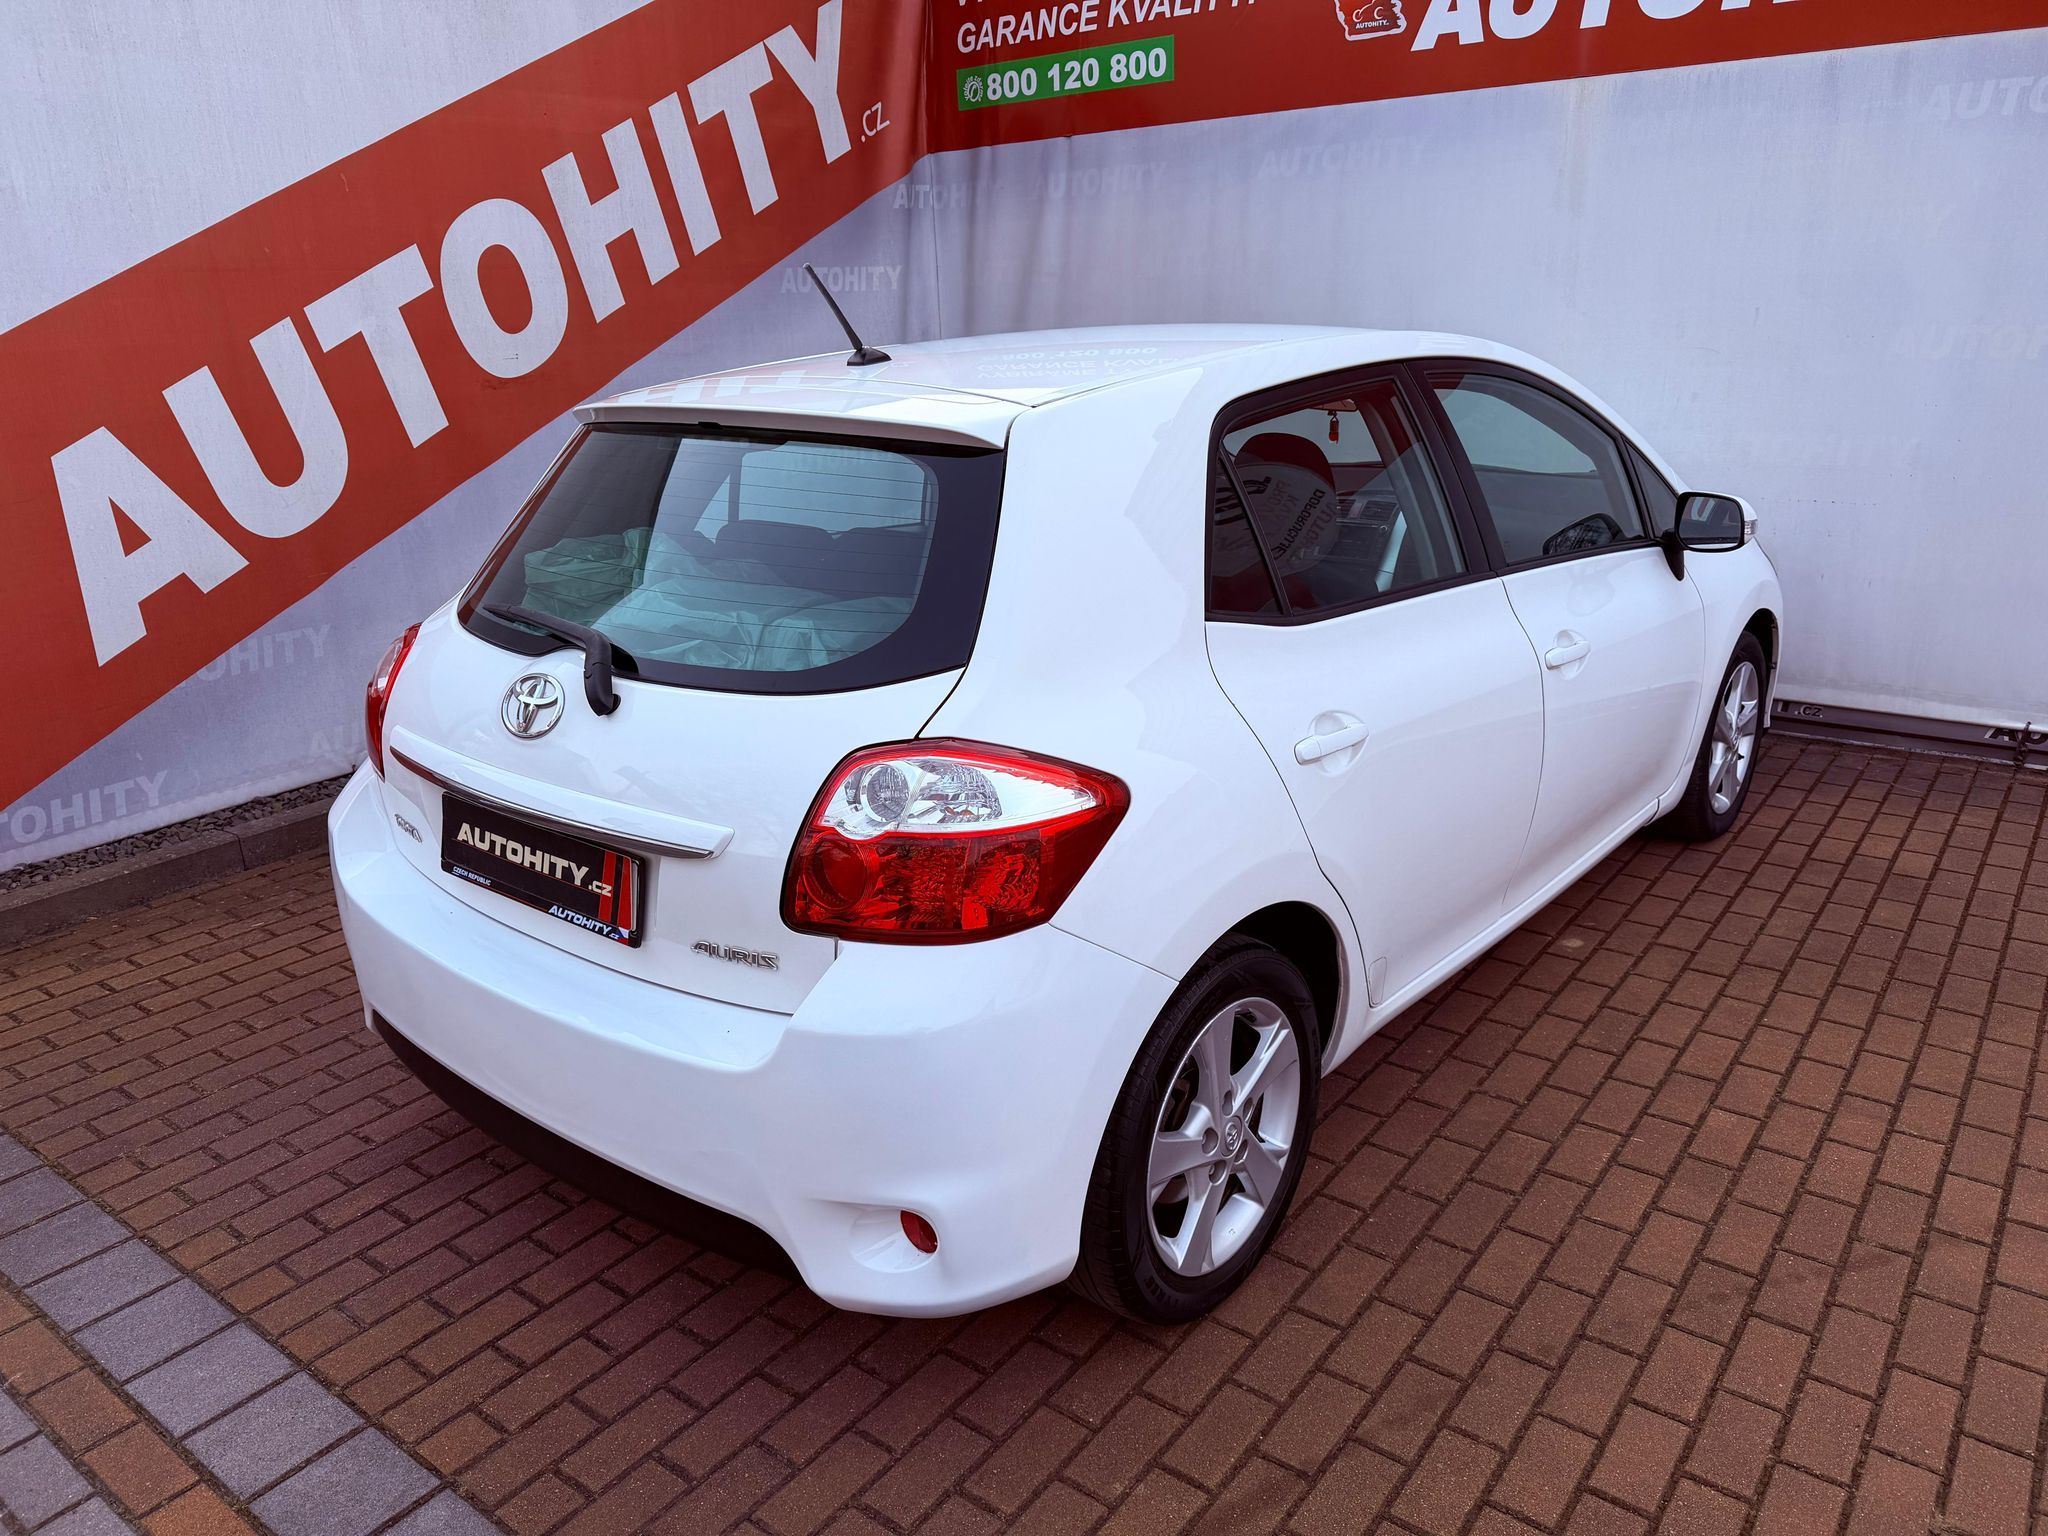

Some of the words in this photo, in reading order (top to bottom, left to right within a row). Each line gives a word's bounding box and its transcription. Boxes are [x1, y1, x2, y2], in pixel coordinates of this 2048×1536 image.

[957, 0, 1099, 53] GARANCE
[986, 67, 1038, 101] 800
[1047, 57, 1099, 92] 120
[1110, 47, 1167, 83] 800
[50, 0, 852, 667] AUTOHITY
[691, 940, 780, 971] AURIS
